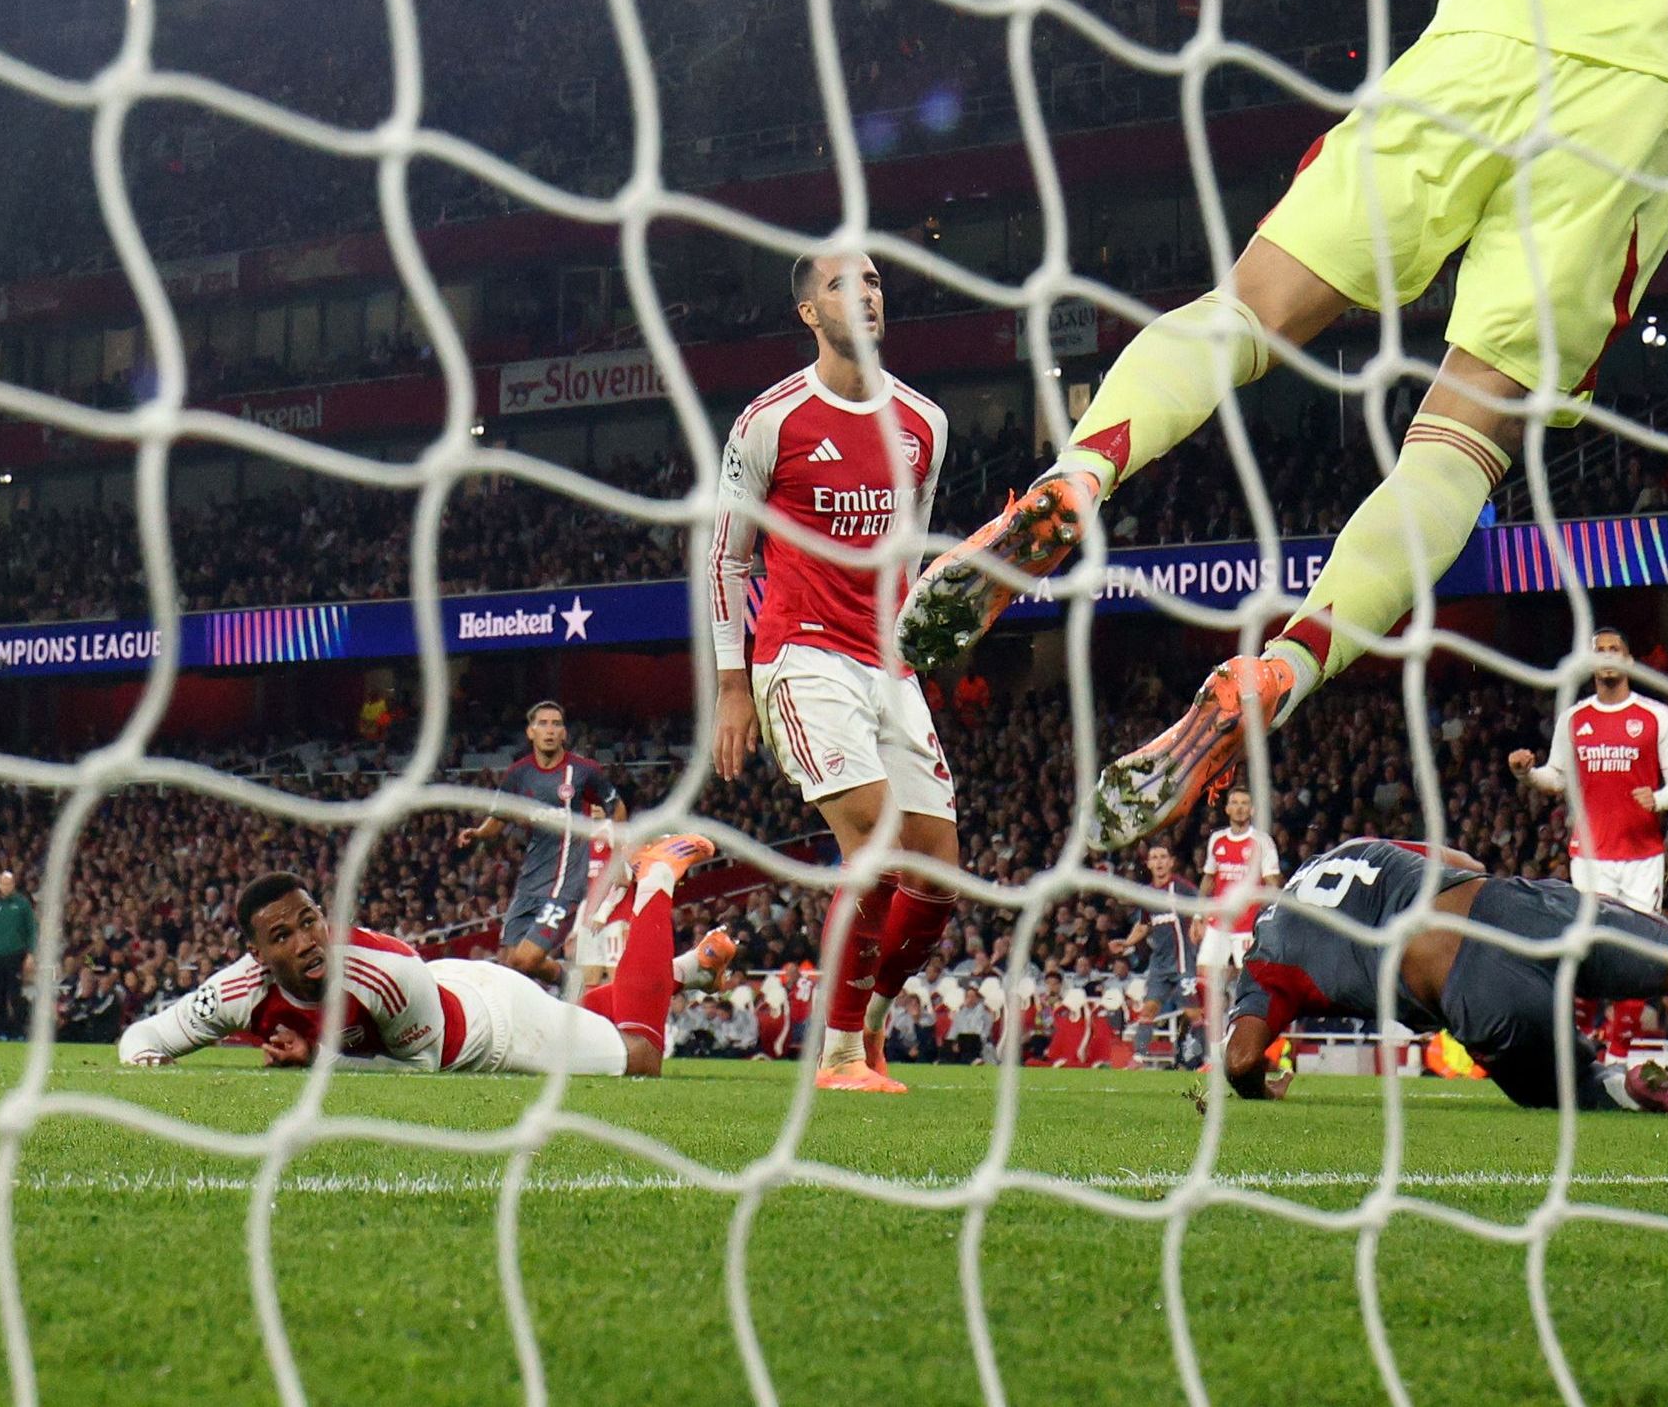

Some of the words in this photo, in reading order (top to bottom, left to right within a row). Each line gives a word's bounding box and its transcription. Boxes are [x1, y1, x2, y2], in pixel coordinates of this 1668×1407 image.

[813, 484, 916, 513] Emira
[458, 608, 554, 640] Heineken
[81, 630, 163, 662] LEAGUE
[1577, 743, 1640, 761] Emirates
[535, 901, 568, 930] 32
